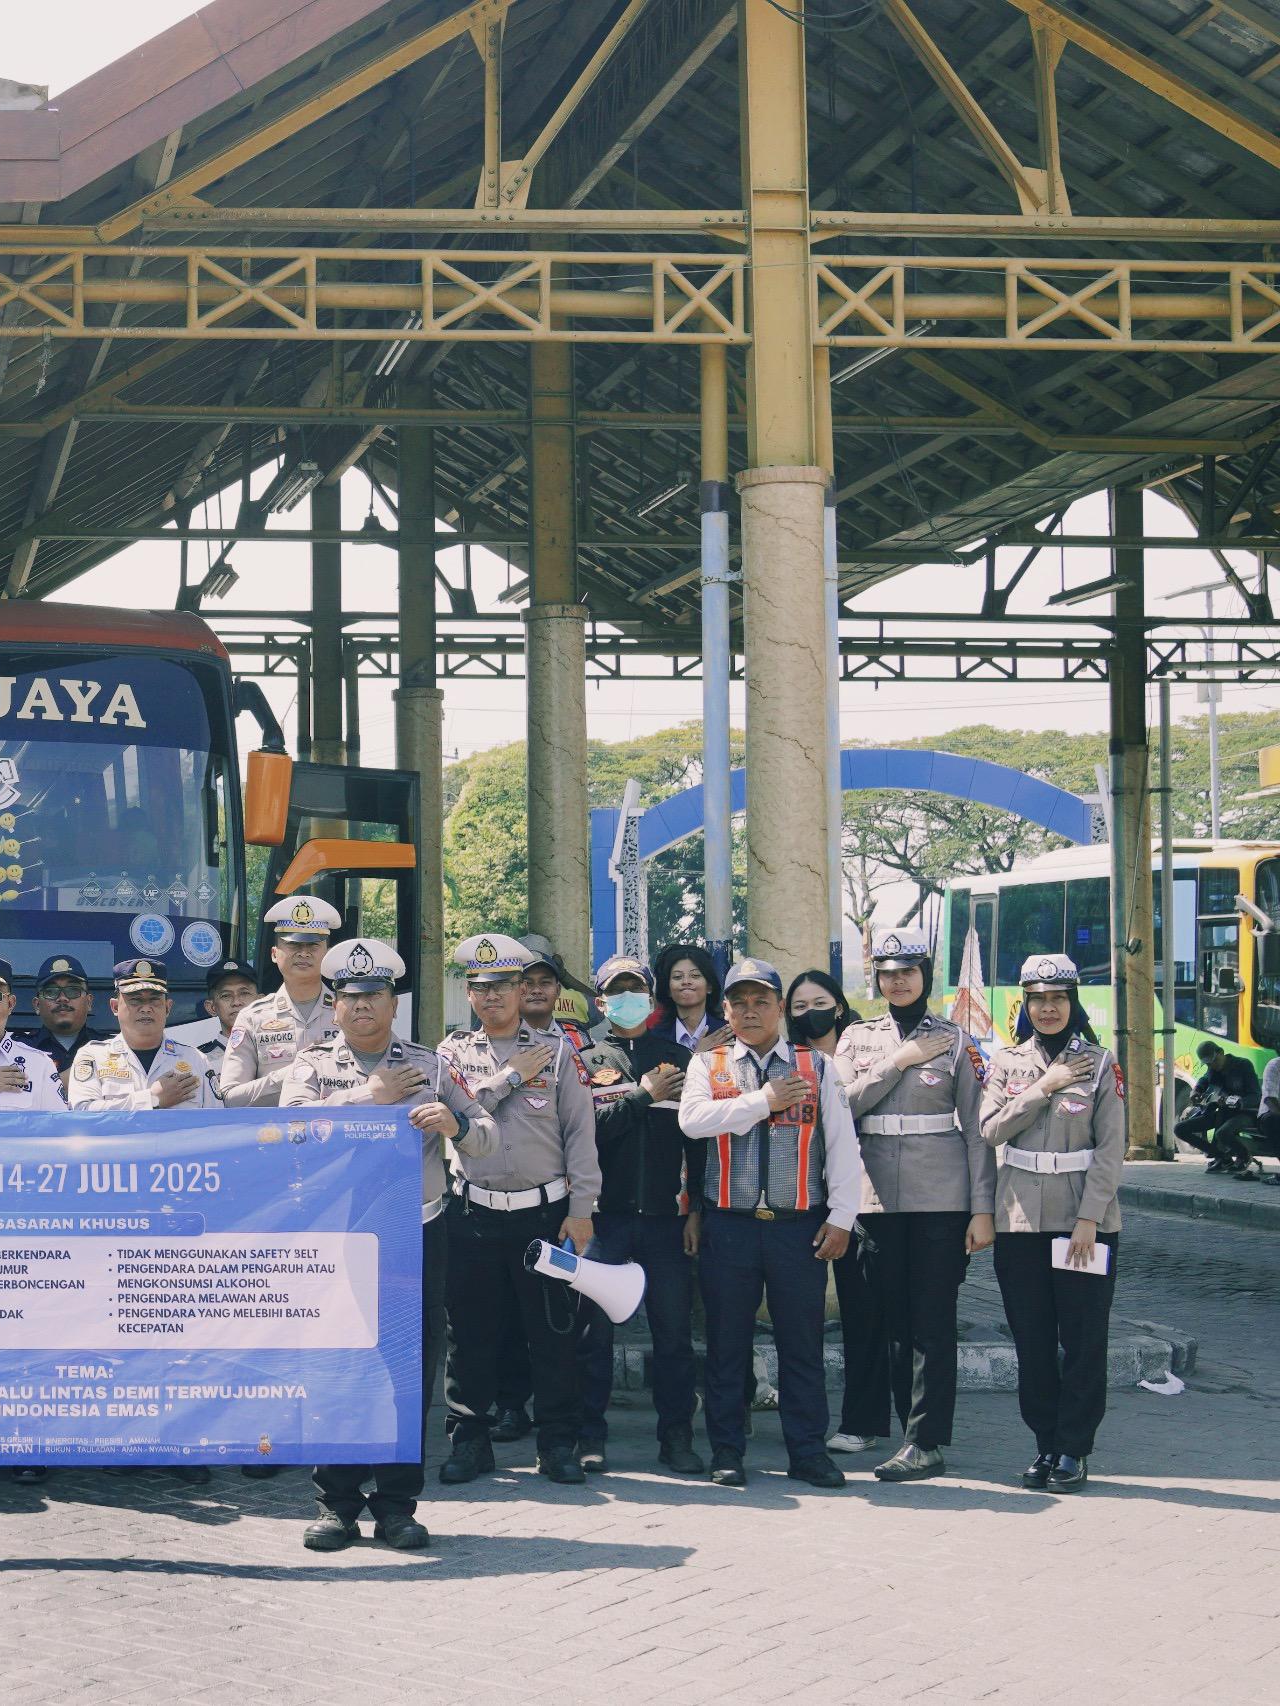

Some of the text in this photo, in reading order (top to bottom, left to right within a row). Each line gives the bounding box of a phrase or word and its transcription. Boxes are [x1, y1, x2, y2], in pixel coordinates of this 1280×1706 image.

[344, 1123, 397, 1132] SATLANTAS
[77, 1163, 138, 1194] JULI
[149, 1162, 220, 1193] 2025
[79, 1217, 151, 1230] KHUSUS
[117, 1249, 152, 1259] TIDAK
[154, 1249, 247, 1259] MENGGUNAKAN
[249, 1249, 292, 1259] SAFETY
[117, 1264, 336, 1274] PENGENDARA DALAM PENGARUH ATAU
[117, 1278, 271, 1289] MENGKONSUMSI ALKOHOL
[117, 1293, 290, 1304] PENGENDARA MELAWAN ARUS
[118, 1308, 320, 1318] PENGENDARA YANG MELEBIHI BATAS
[118, 1323, 184, 1333] KECEPATAN
[55, 1365, 115, 1380] TEMA:
[40, 1386, 107, 1399] LINTAS
[113, 1386, 159, 1399] DEMI
[165, 1385, 308, 1399] TERWUJUDNYA
[106, 1404, 160, 1417] EMAS
